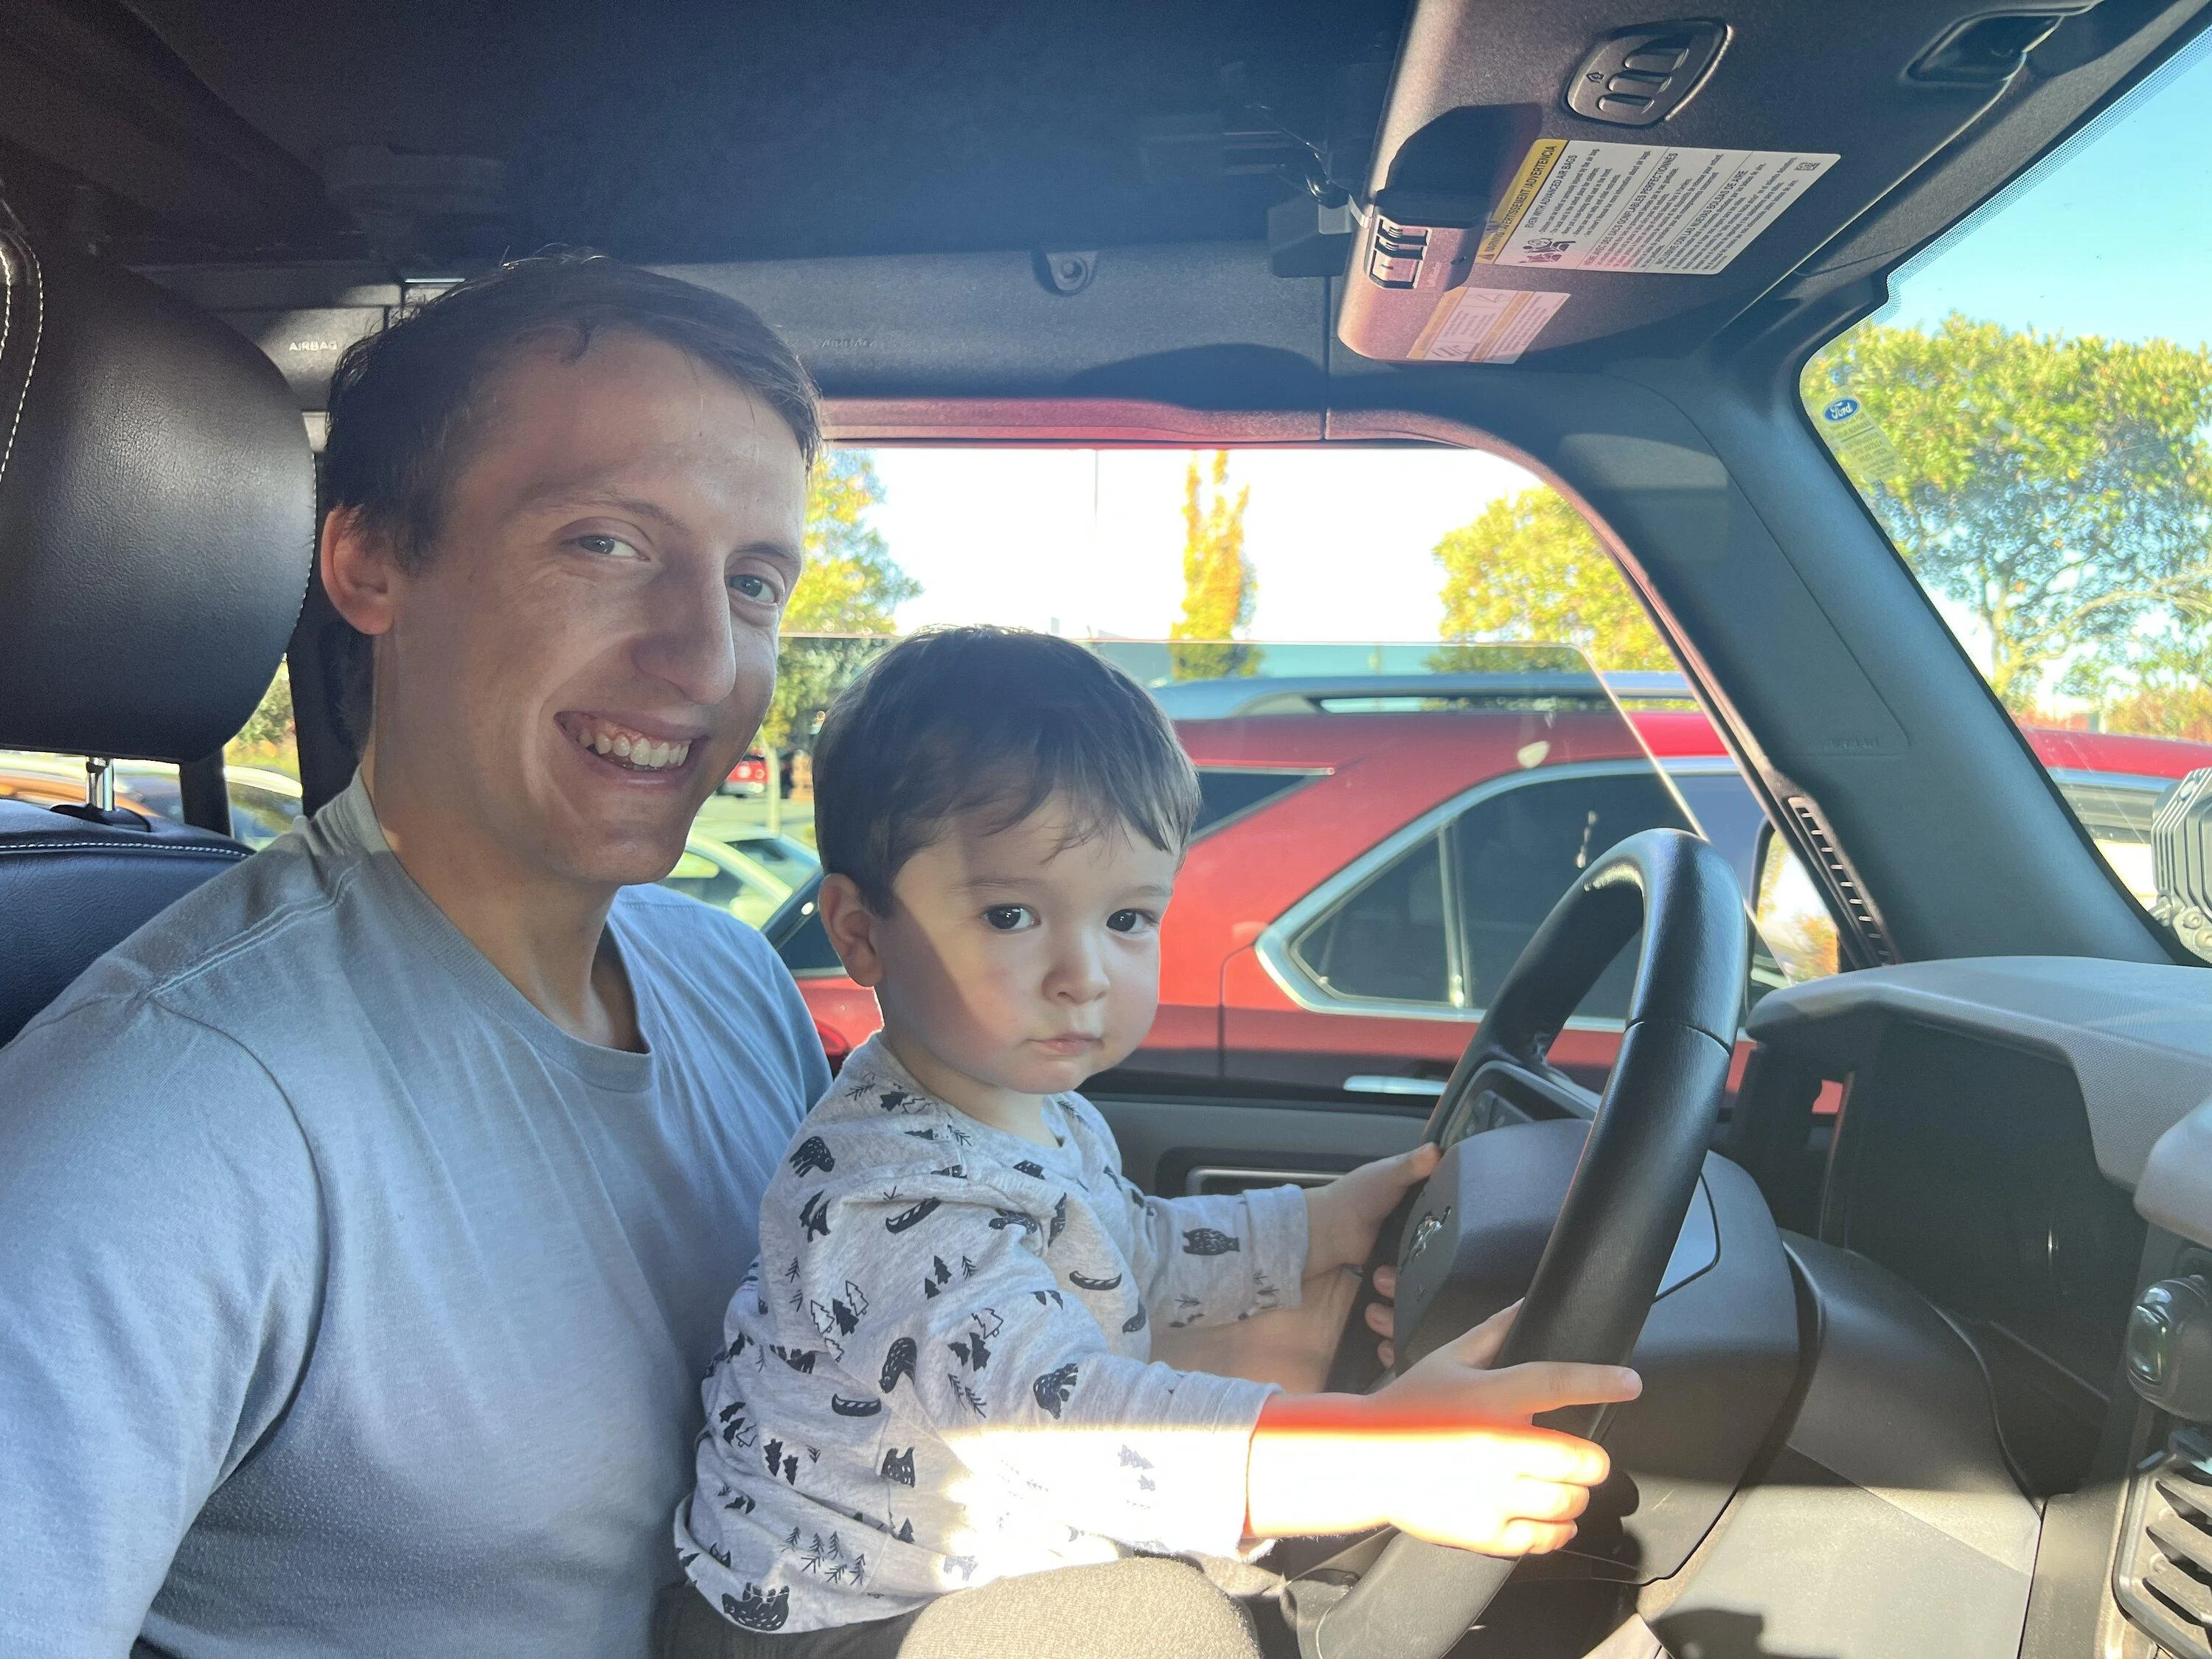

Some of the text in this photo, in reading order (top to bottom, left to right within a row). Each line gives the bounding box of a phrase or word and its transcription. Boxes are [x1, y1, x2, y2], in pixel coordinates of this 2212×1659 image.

[1560, 155, 1578, 169] BAGS
[1554, 170, 1569, 178] AIR
[1538, 179, 1563, 204] ADVANCED
[1531, 205, 1546, 215] WITH
[288, 341, 338, 352] AIRBAG
[1829, 402, 1853, 420] Ford
